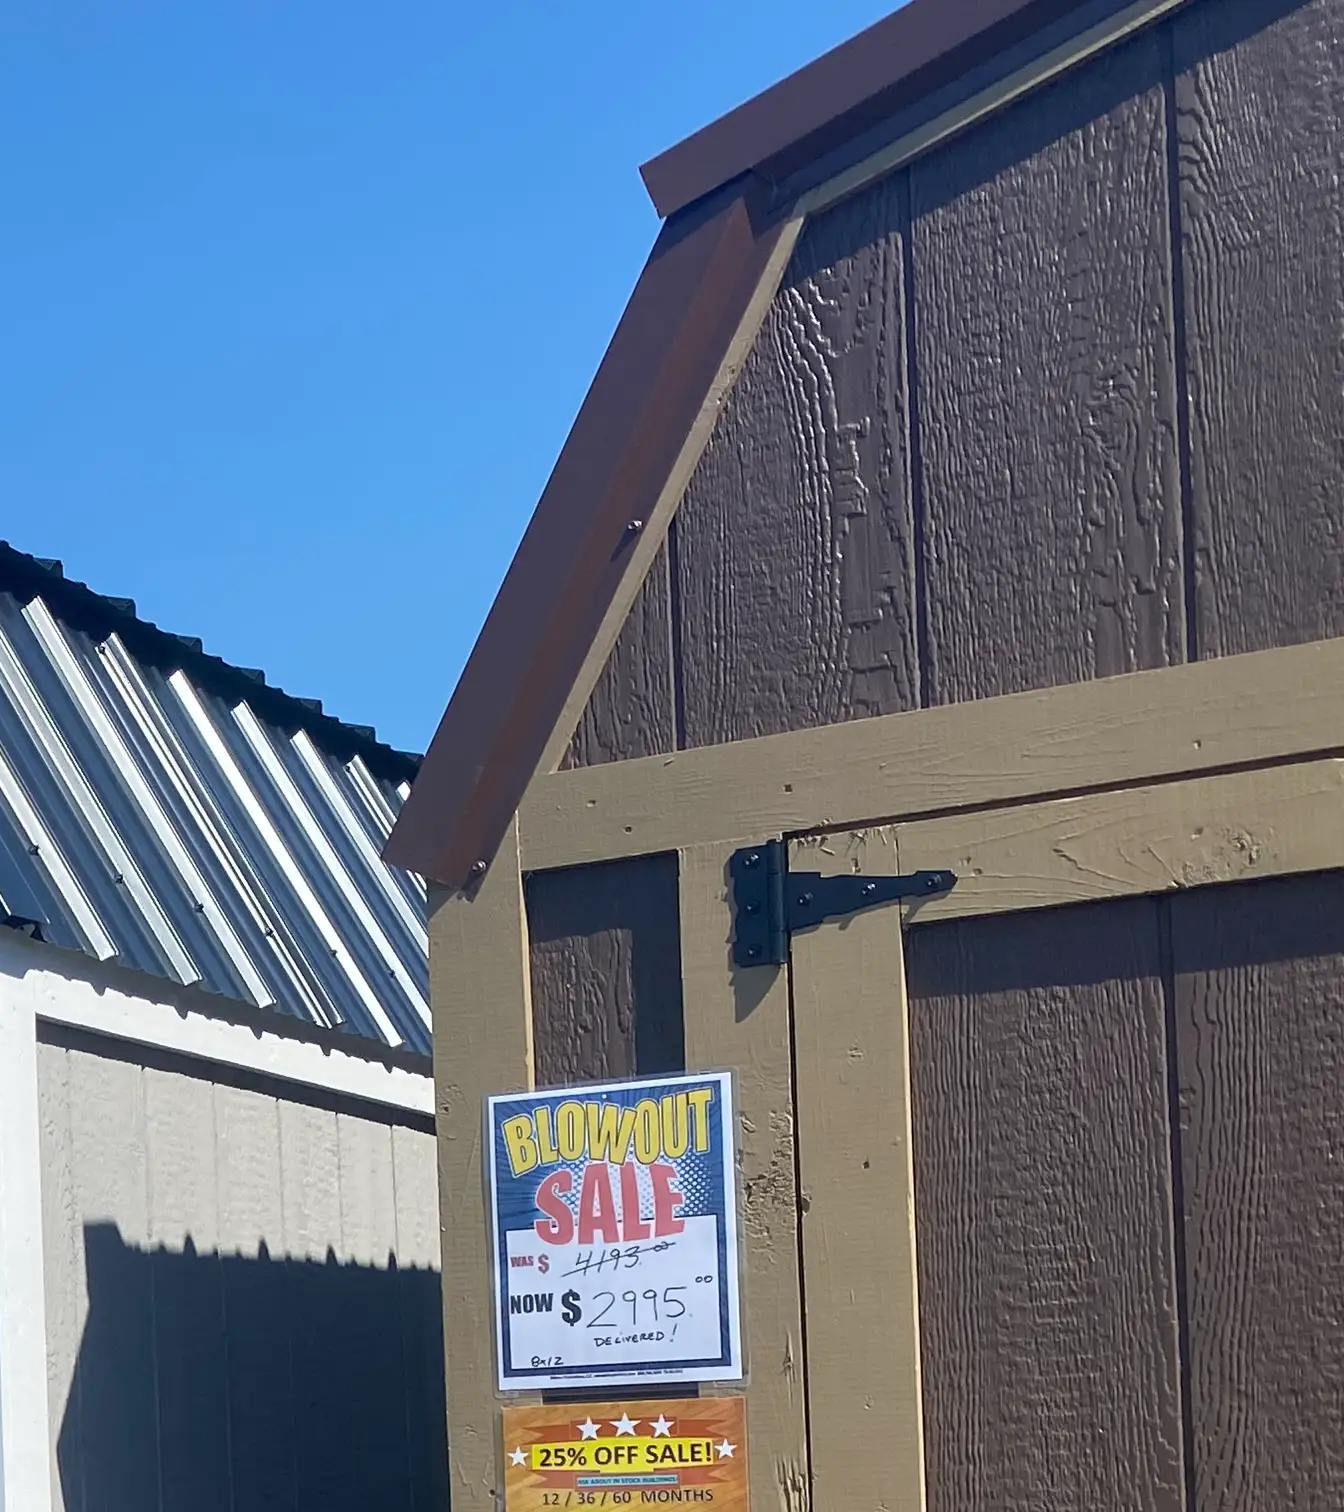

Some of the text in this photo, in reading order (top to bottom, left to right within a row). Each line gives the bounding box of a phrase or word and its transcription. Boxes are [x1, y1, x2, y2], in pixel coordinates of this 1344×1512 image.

[502, 1087, 713, 1177] BLOWOUT
[534, 1162, 685, 1245] SALE
[510, 1256, 533, 1268] WAS
[510, 1293, 554, 1314] NOW
[539, 1442, 713, 1467] 25% OFF SALE!
[542, 1492, 560, 1506] 12
[577, 1491, 596, 1505] 36
[613, 1491, 632, 1504] 60
[640, 1488, 714, 1503] MONTHS
